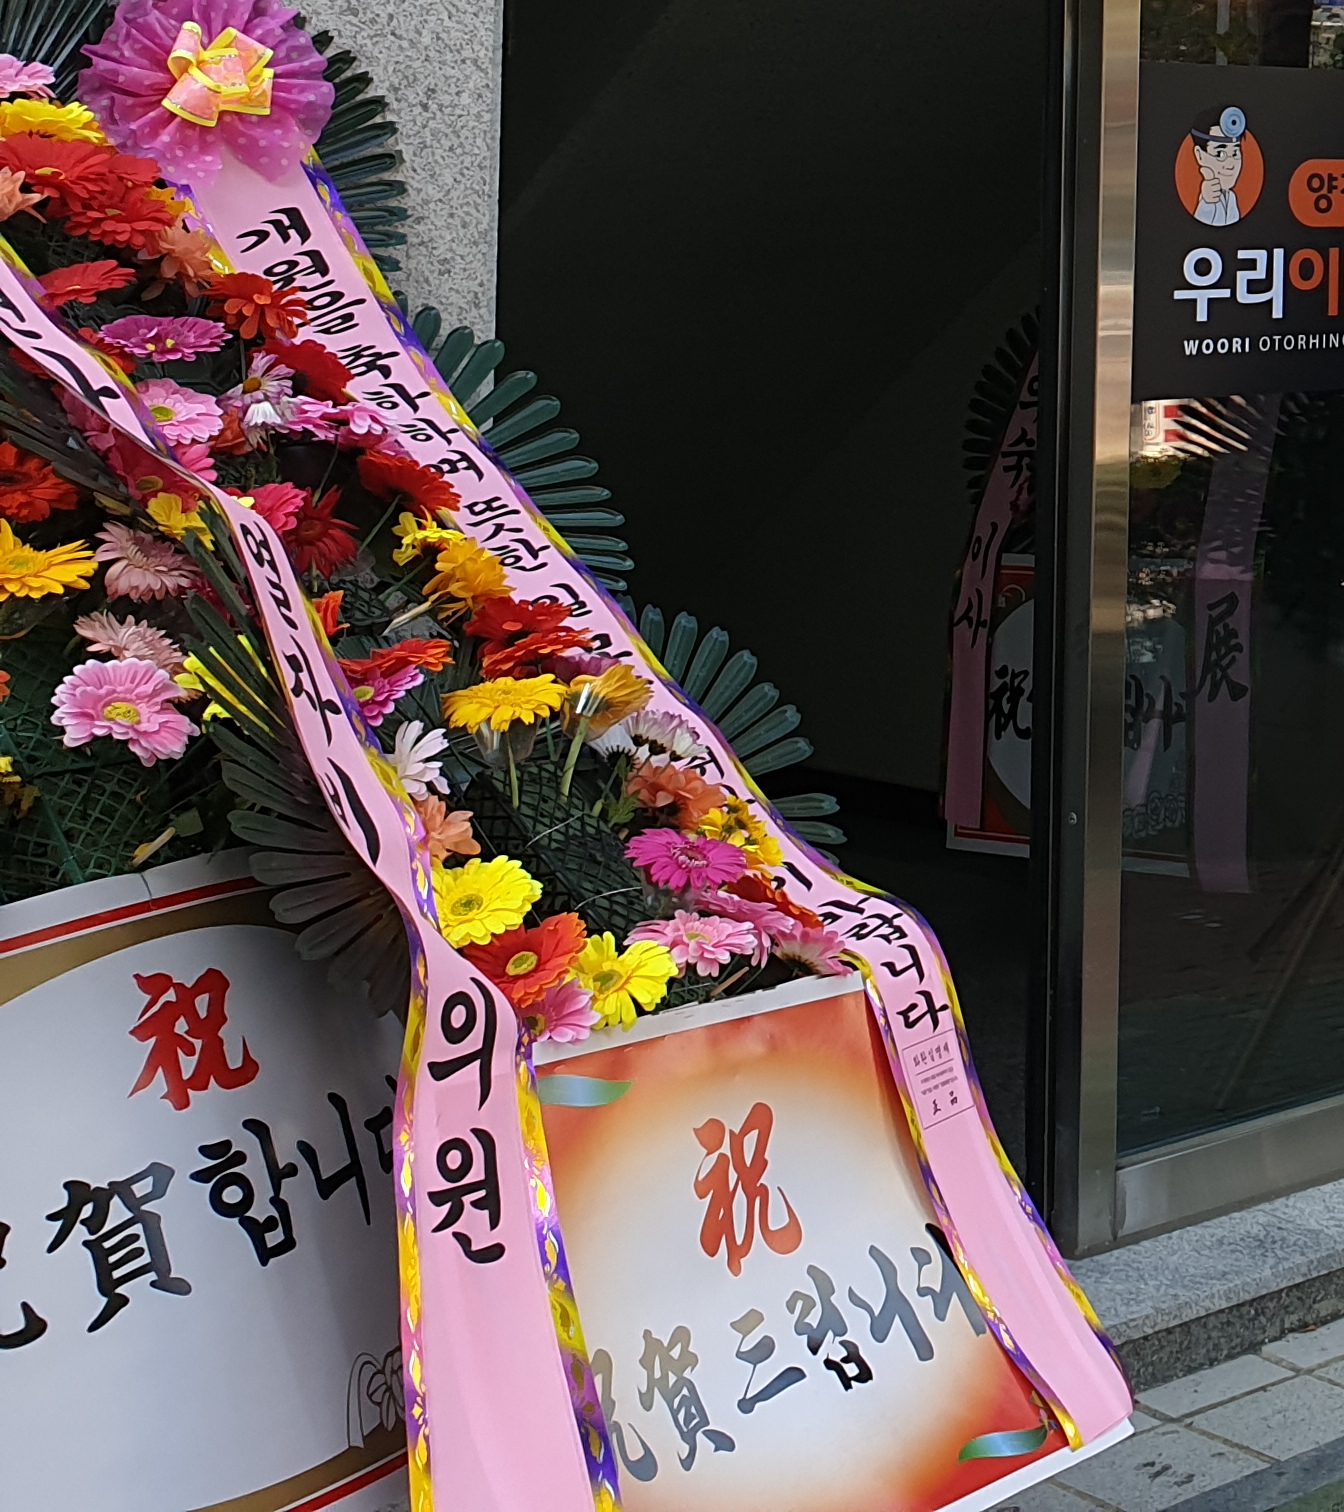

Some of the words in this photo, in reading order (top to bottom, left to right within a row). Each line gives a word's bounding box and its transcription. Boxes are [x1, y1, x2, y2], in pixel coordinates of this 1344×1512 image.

[1183, 336, 1251, 357] WOORI
[128, 967, 260, 1111] 祝
[692, 1101, 803, 1278] 祝
